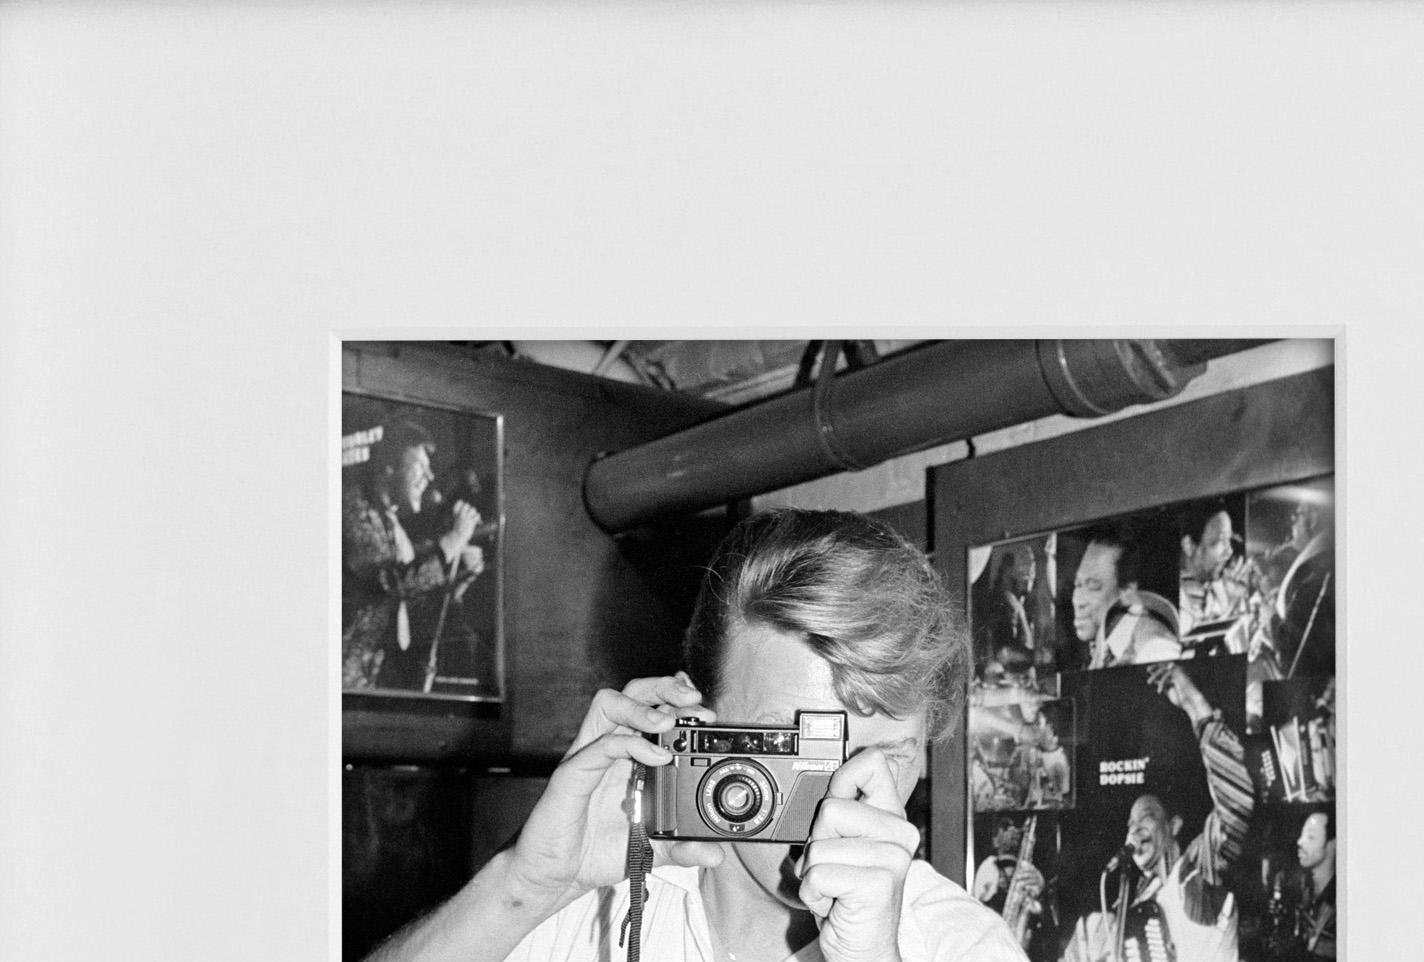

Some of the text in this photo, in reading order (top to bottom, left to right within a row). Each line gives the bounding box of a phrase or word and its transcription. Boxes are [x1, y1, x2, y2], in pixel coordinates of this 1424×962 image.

[792, 761, 823, 771] Nikon
[1100, 757, 1150, 772] ROCKIN'
[1100, 772, 1144, 785] DOPSIE
